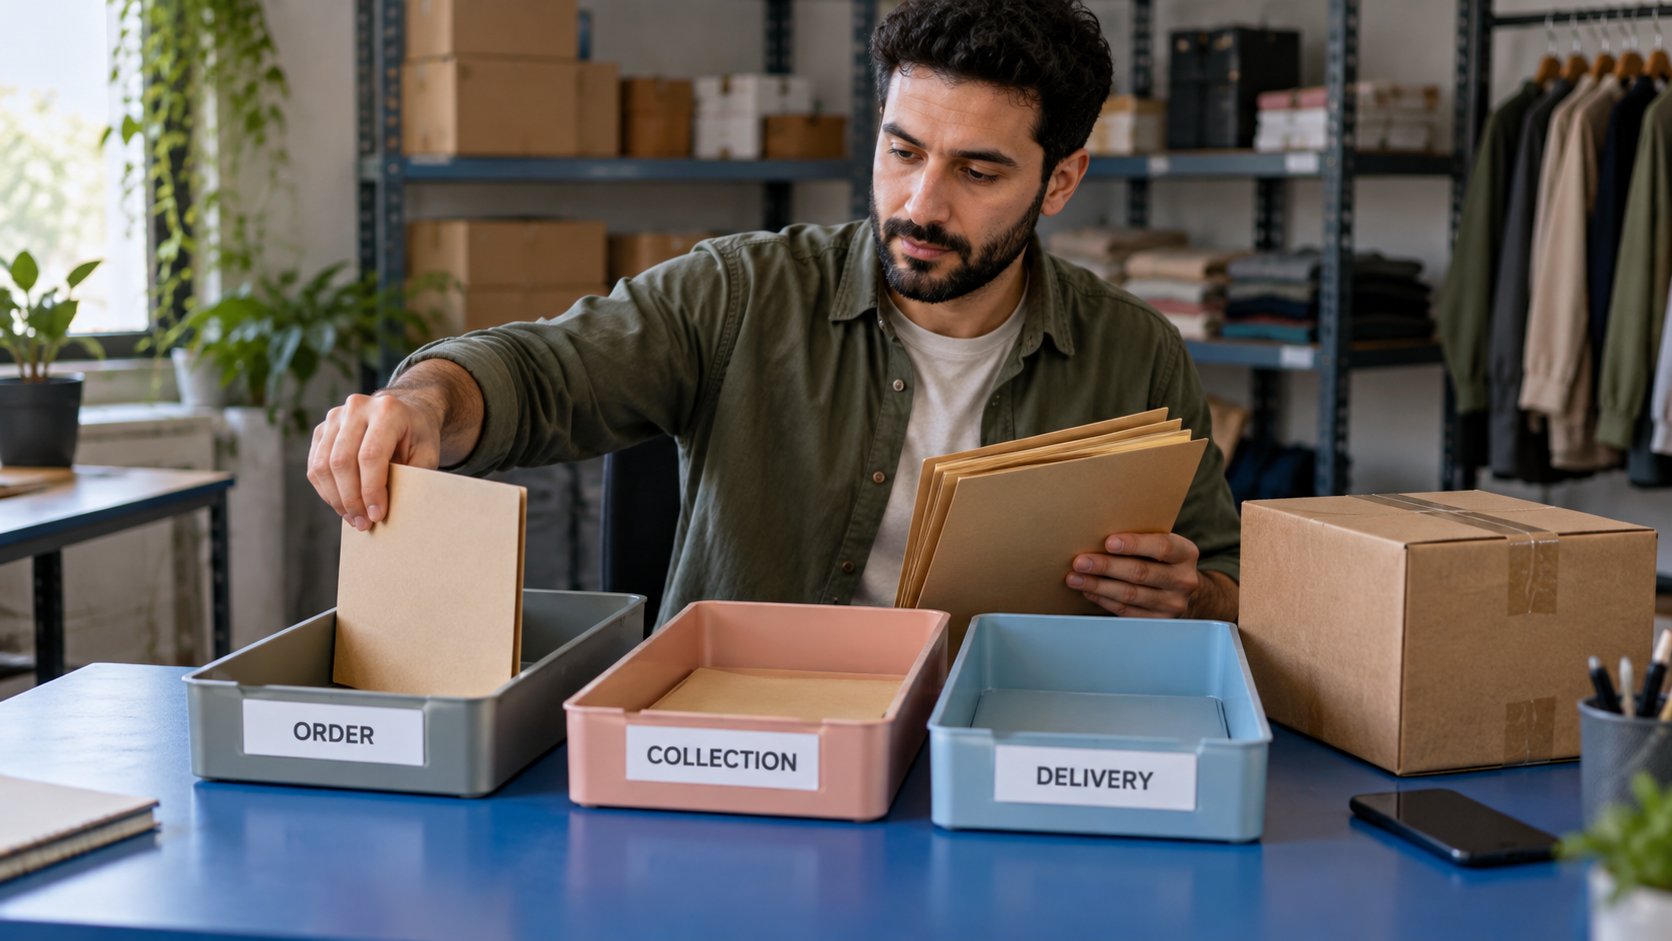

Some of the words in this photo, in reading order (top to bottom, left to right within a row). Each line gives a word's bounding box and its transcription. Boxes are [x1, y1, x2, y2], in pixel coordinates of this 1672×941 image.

[293, 721, 374, 746] ORDER
[647, 745, 798, 773] COLLECTION
[1036, 765, 1154, 791] DELIVERY
